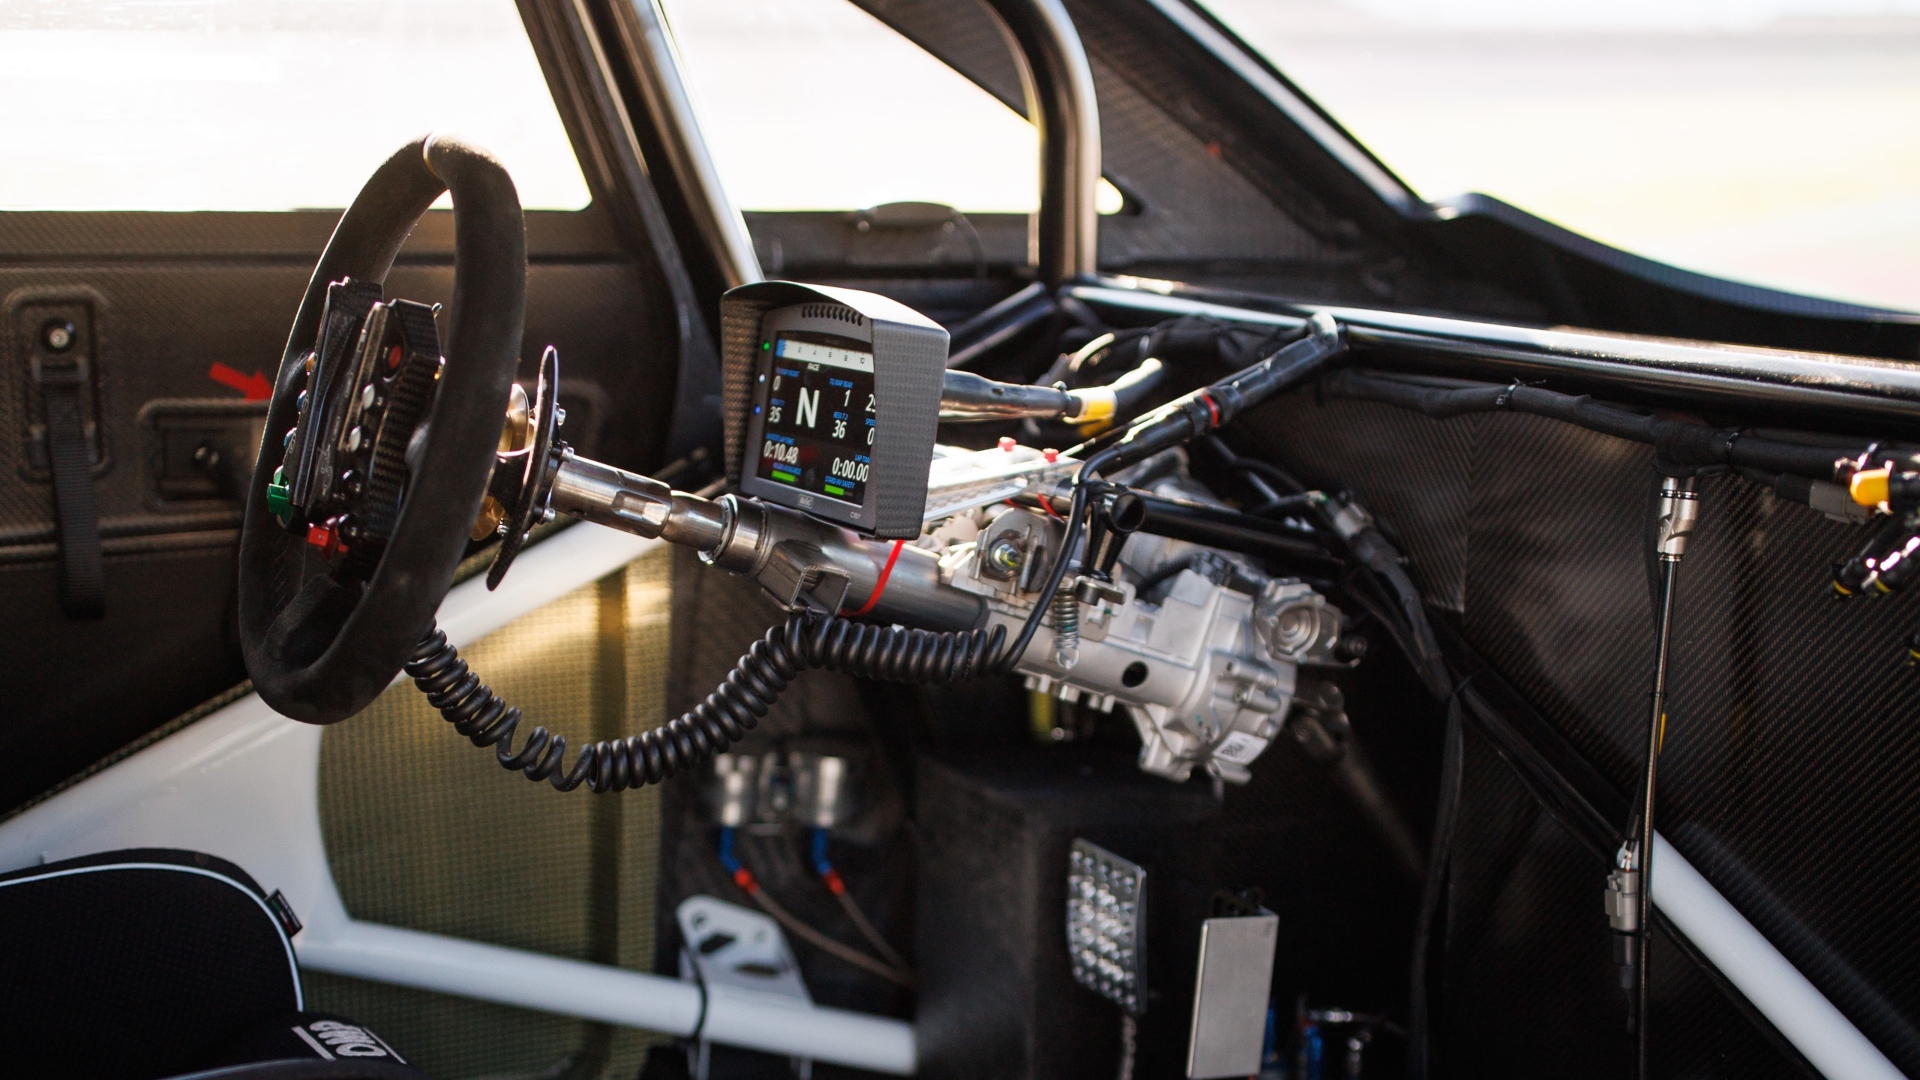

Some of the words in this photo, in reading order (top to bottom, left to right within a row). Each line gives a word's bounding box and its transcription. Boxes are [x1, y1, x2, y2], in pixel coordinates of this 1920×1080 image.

[773, 375, 781, 392] 0
[795, 386, 820, 428] N
[844, 389, 851, 407] 1
[768, 406, 782, 423] 35
[832, 419, 847, 439] 36
[867, 427, 875, 446] 0
[763, 440, 799, 464] 0:10.48
[832, 457, 869, 482] 0:00.00
[309, 1020, 387, 1057] OMP
